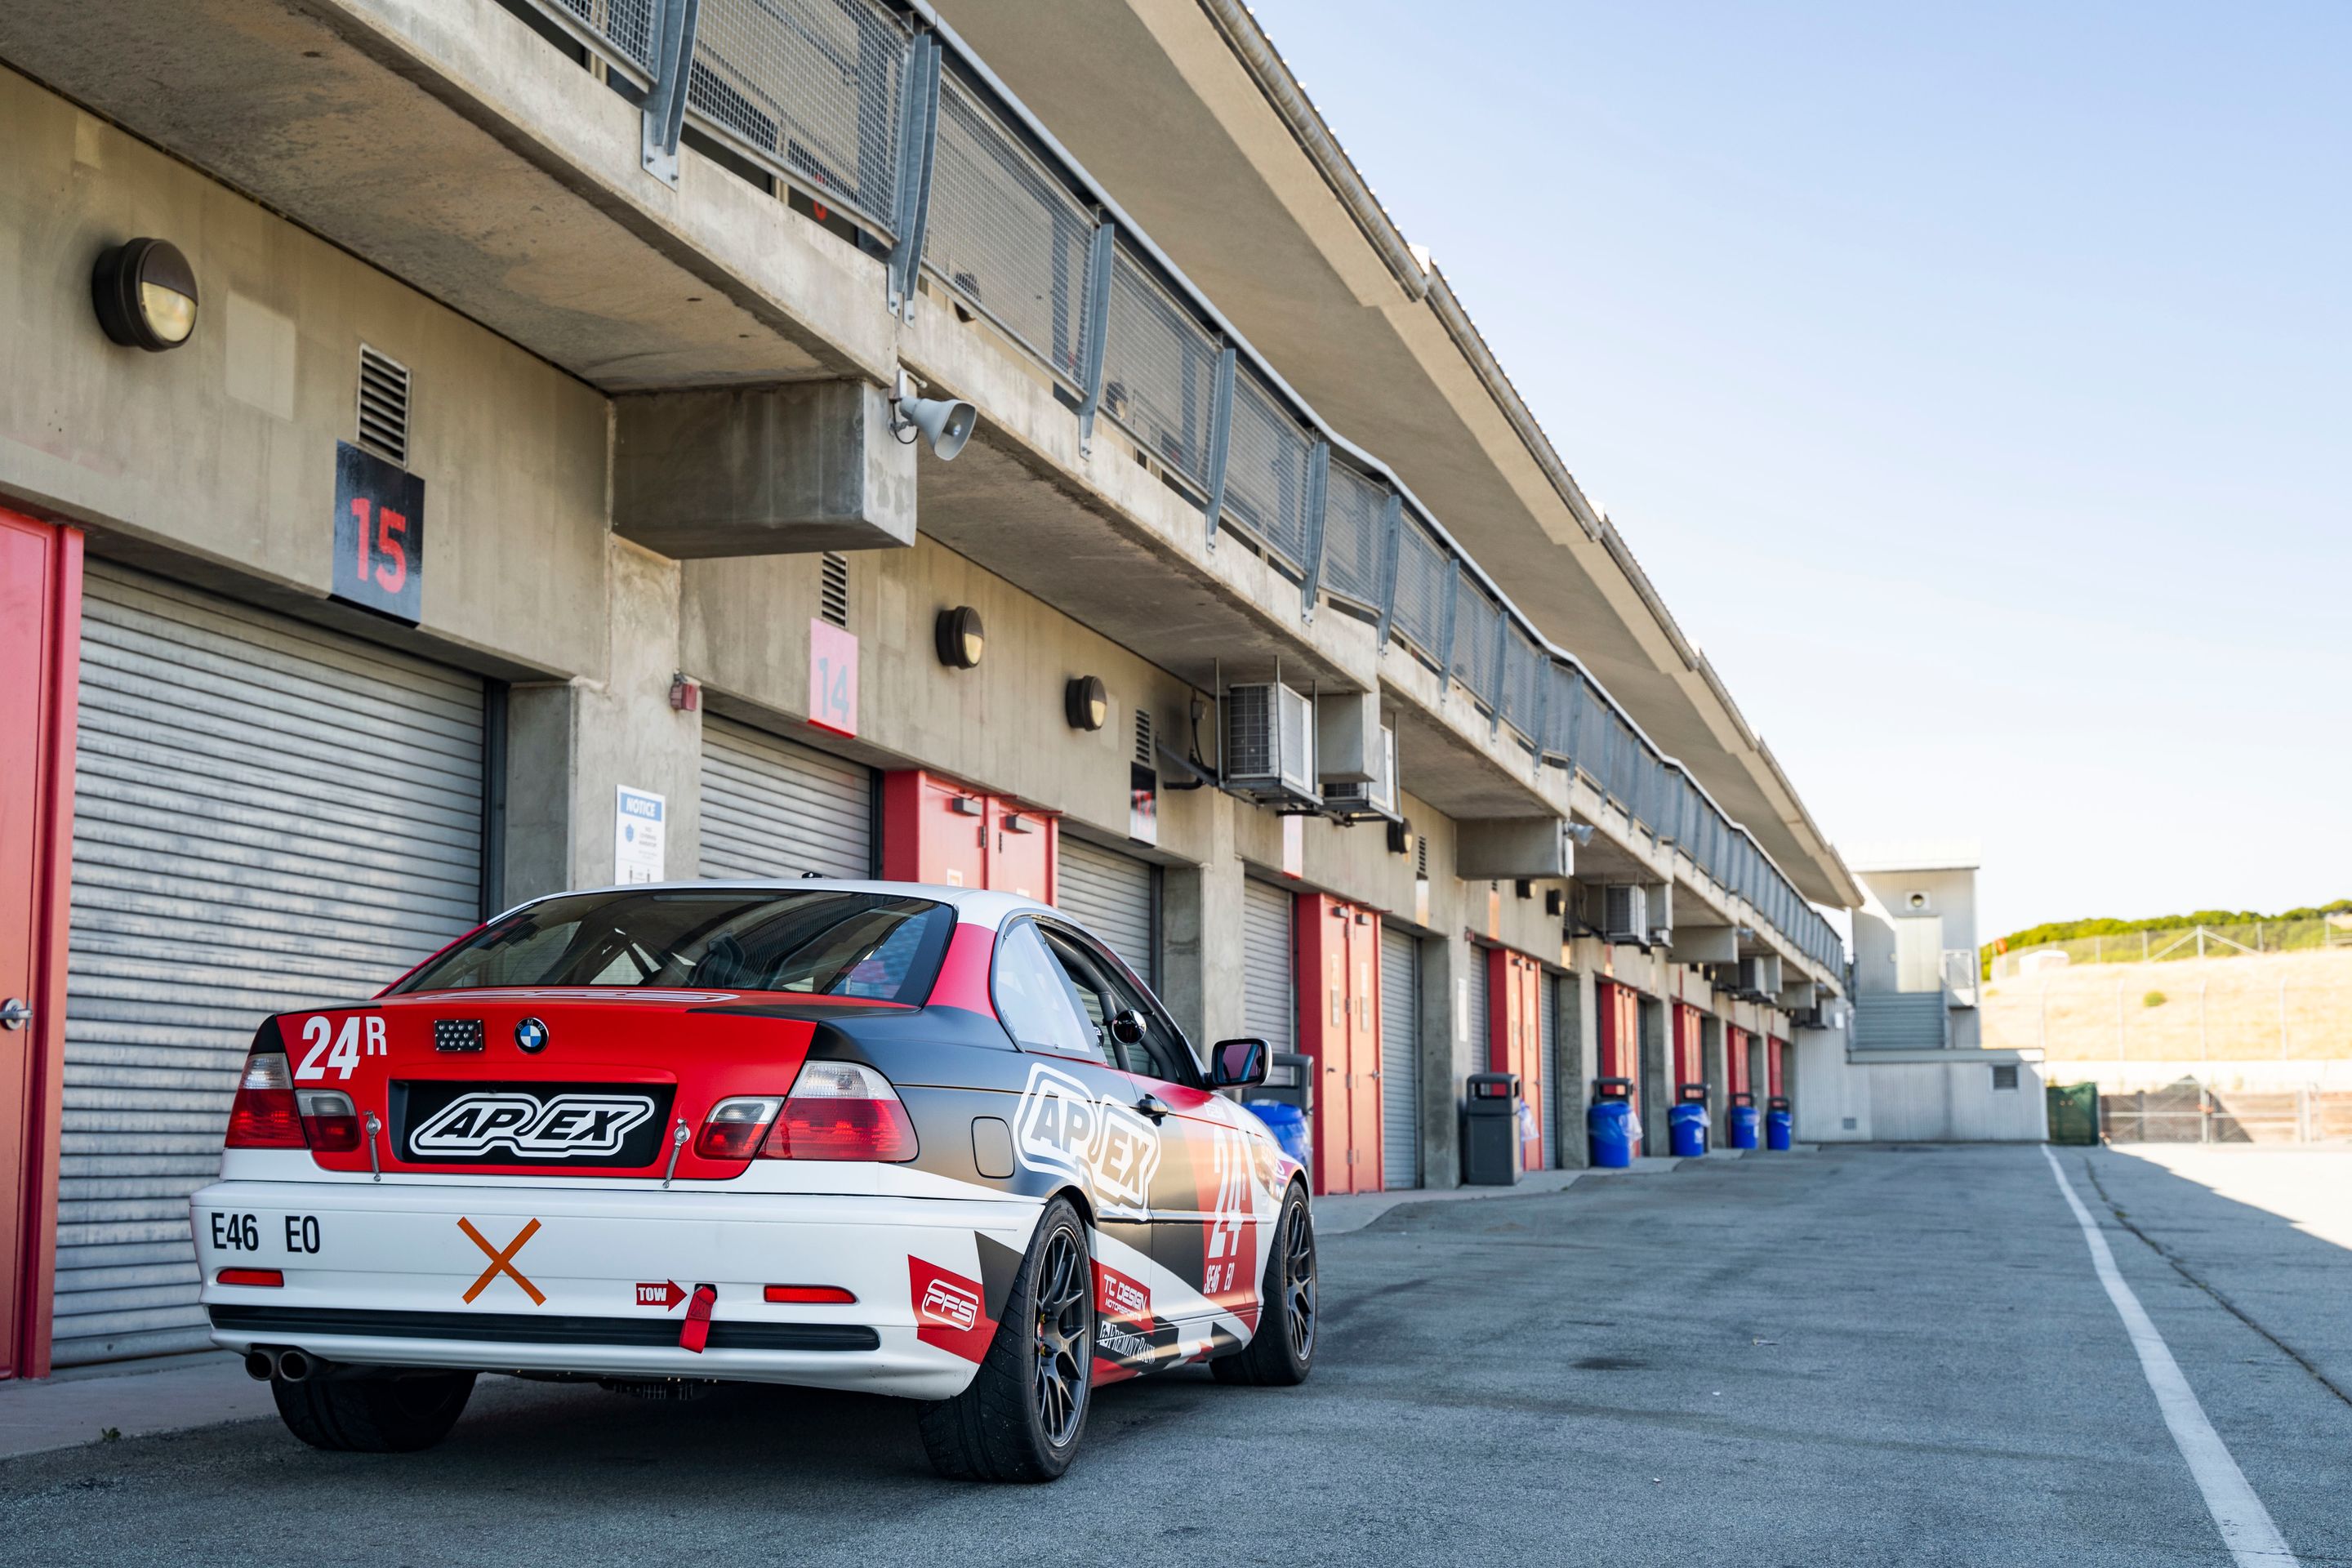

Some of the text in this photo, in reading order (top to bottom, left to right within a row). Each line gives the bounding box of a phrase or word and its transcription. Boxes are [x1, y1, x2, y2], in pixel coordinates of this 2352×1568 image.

[350, 497, 407, 594] 15
[818, 657, 849, 724] 14
[626, 797, 657, 817] NOTICE
[418, 1102, 646, 1147] APEX
[1022, 1080, 1156, 1205] APEX
[1208, 1125, 1243, 1258] 24
[211, 1212, 259, 1251] E46
[638, 1287, 667, 1302] TOW
[925, 1284, 978, 1326] PFS
[1103, 1274, 1147, 1312] TC DESIGN
